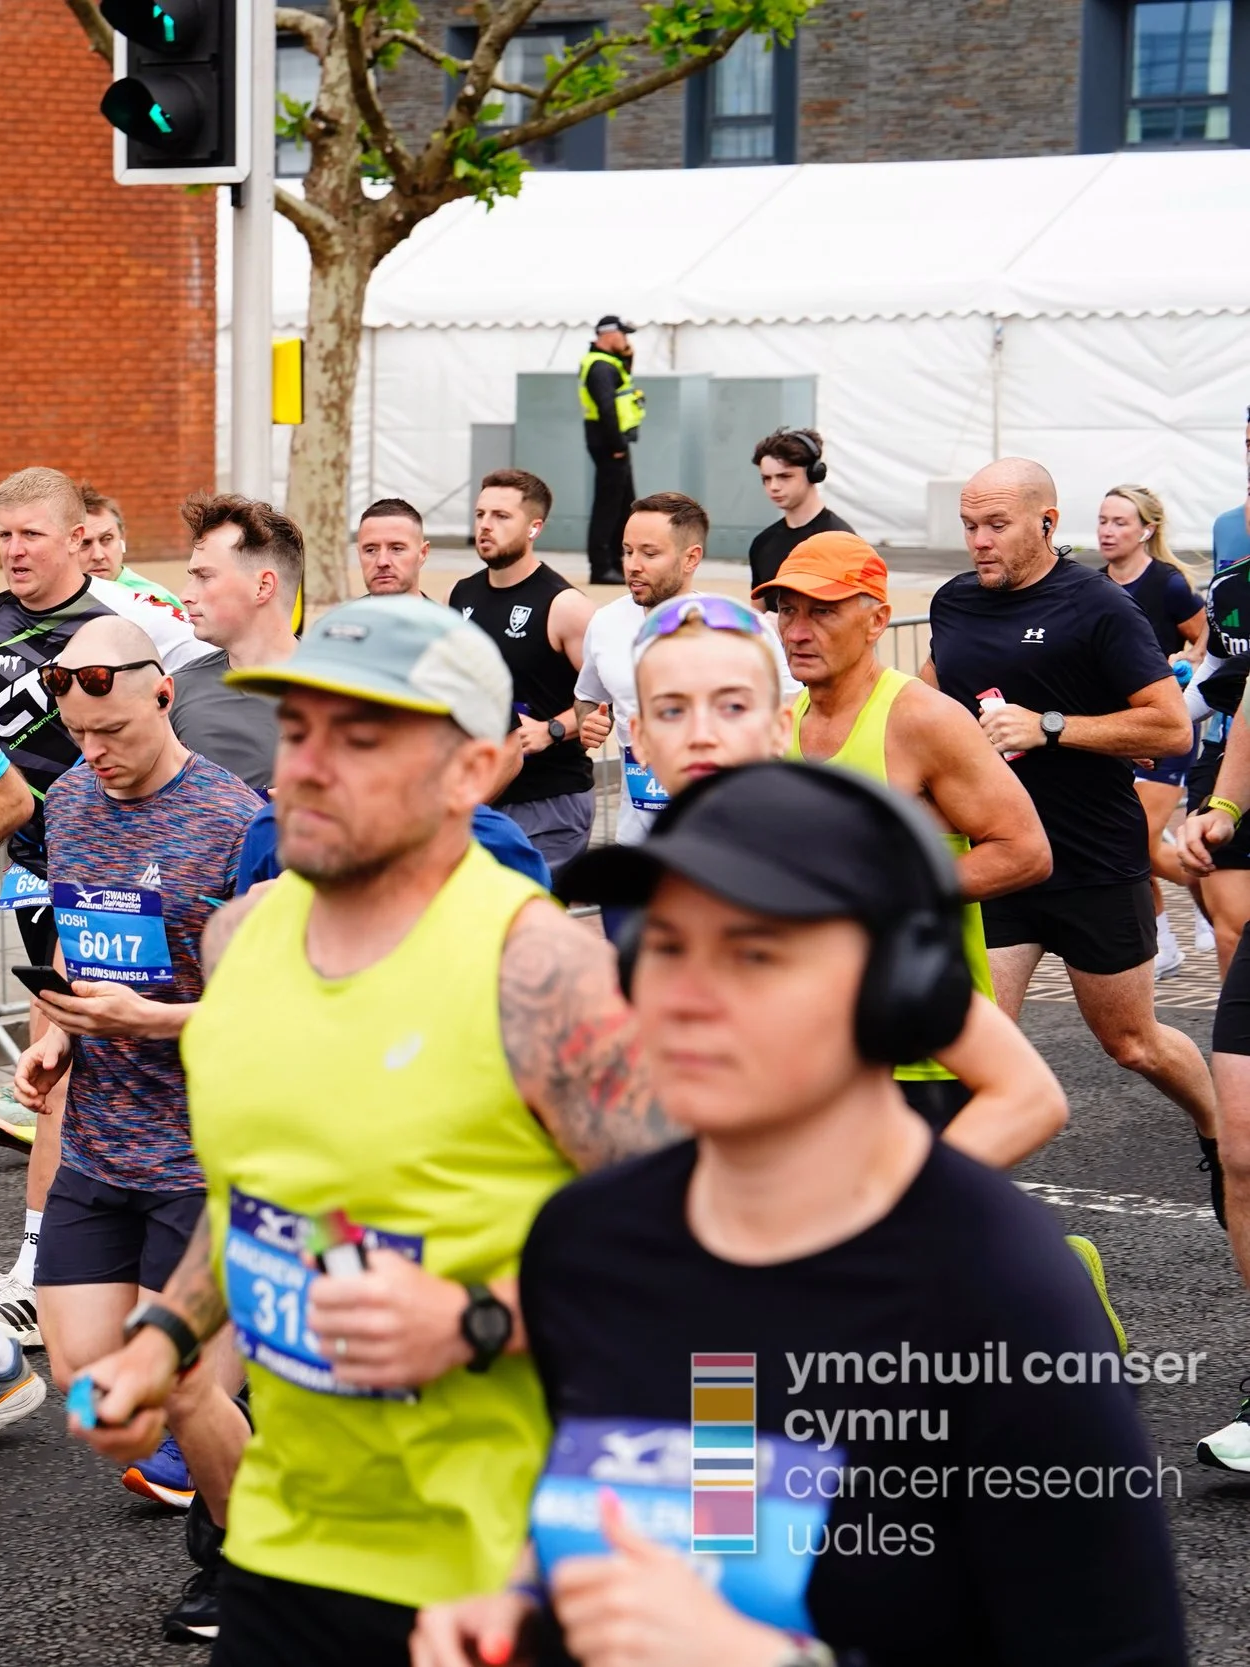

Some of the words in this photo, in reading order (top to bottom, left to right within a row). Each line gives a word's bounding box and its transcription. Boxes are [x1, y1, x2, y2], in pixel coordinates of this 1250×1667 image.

[1220, 632, 1250, 656] Em
[27, 707, 60, 734] TRIATHLO
[105, 890, 141, 902] SWANSEA
[58, 912, 88, 928] JOSH
[79, 929, 143, 963] 6017
[81, 966, 150, 981] #RUNSWANSEA
[251, 1277, 320, 1354] 31
